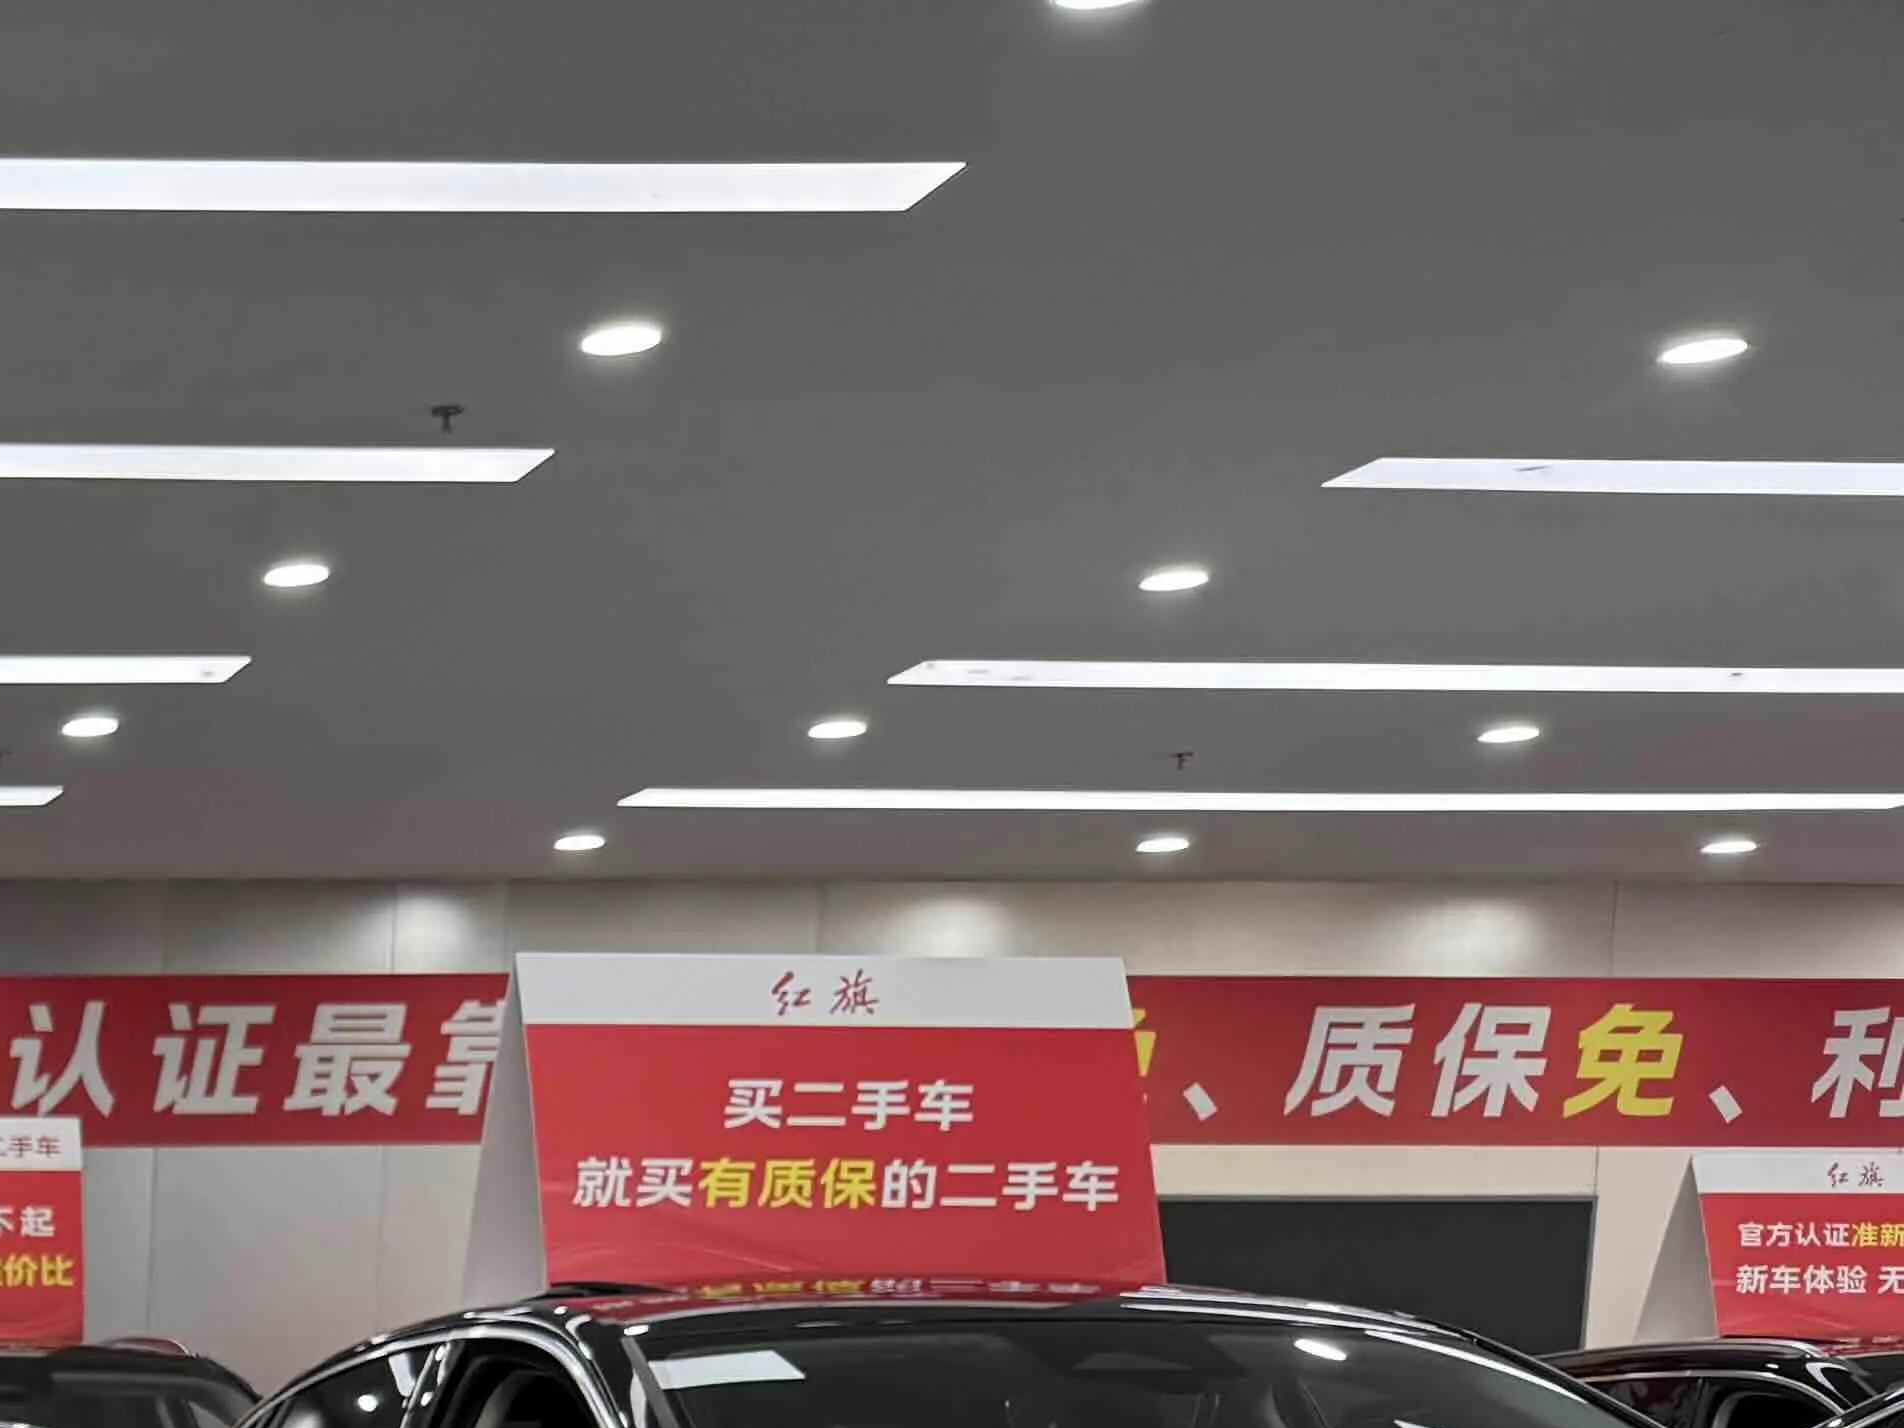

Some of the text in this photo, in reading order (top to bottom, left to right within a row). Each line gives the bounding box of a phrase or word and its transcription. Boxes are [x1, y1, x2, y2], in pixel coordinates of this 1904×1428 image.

[770, 967, 881, 1017] 红旗
[723, 1078, 975, 1132] 买二手车
[571, 1156, 1121, 1212] 就买有质保的二手车
[1827, 1161, 1885, 1188] 红旗
[1738, 1221, 1904, 1248] 官方认证准新
[1735, 1264, 1868, 1295] 新车体验
